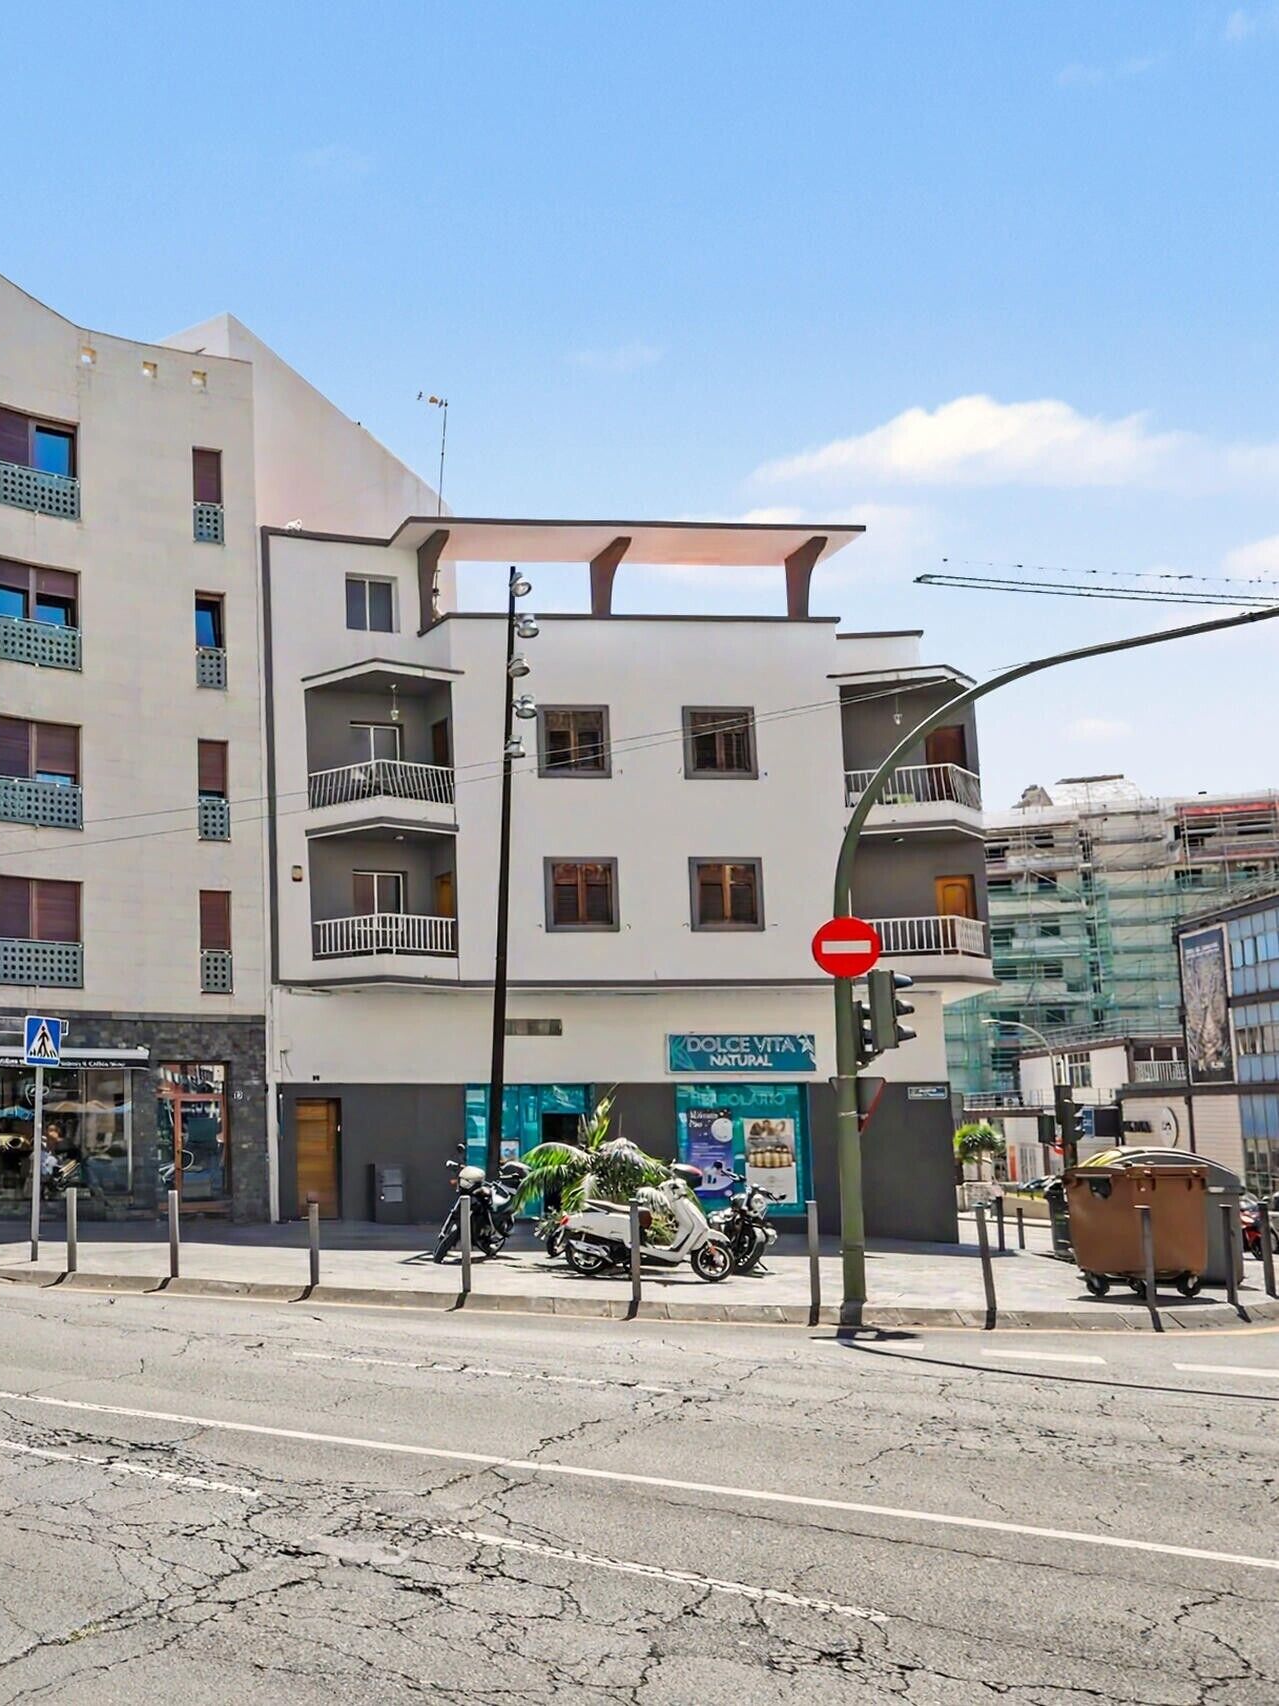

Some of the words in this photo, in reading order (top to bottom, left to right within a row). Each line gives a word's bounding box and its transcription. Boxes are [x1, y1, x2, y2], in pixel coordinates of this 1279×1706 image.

[687, 1037, 750, 1053] DOLCE
[753, 1037, 796, 1053] VITA
[710, 1054, 773, 1066] NATURAL
